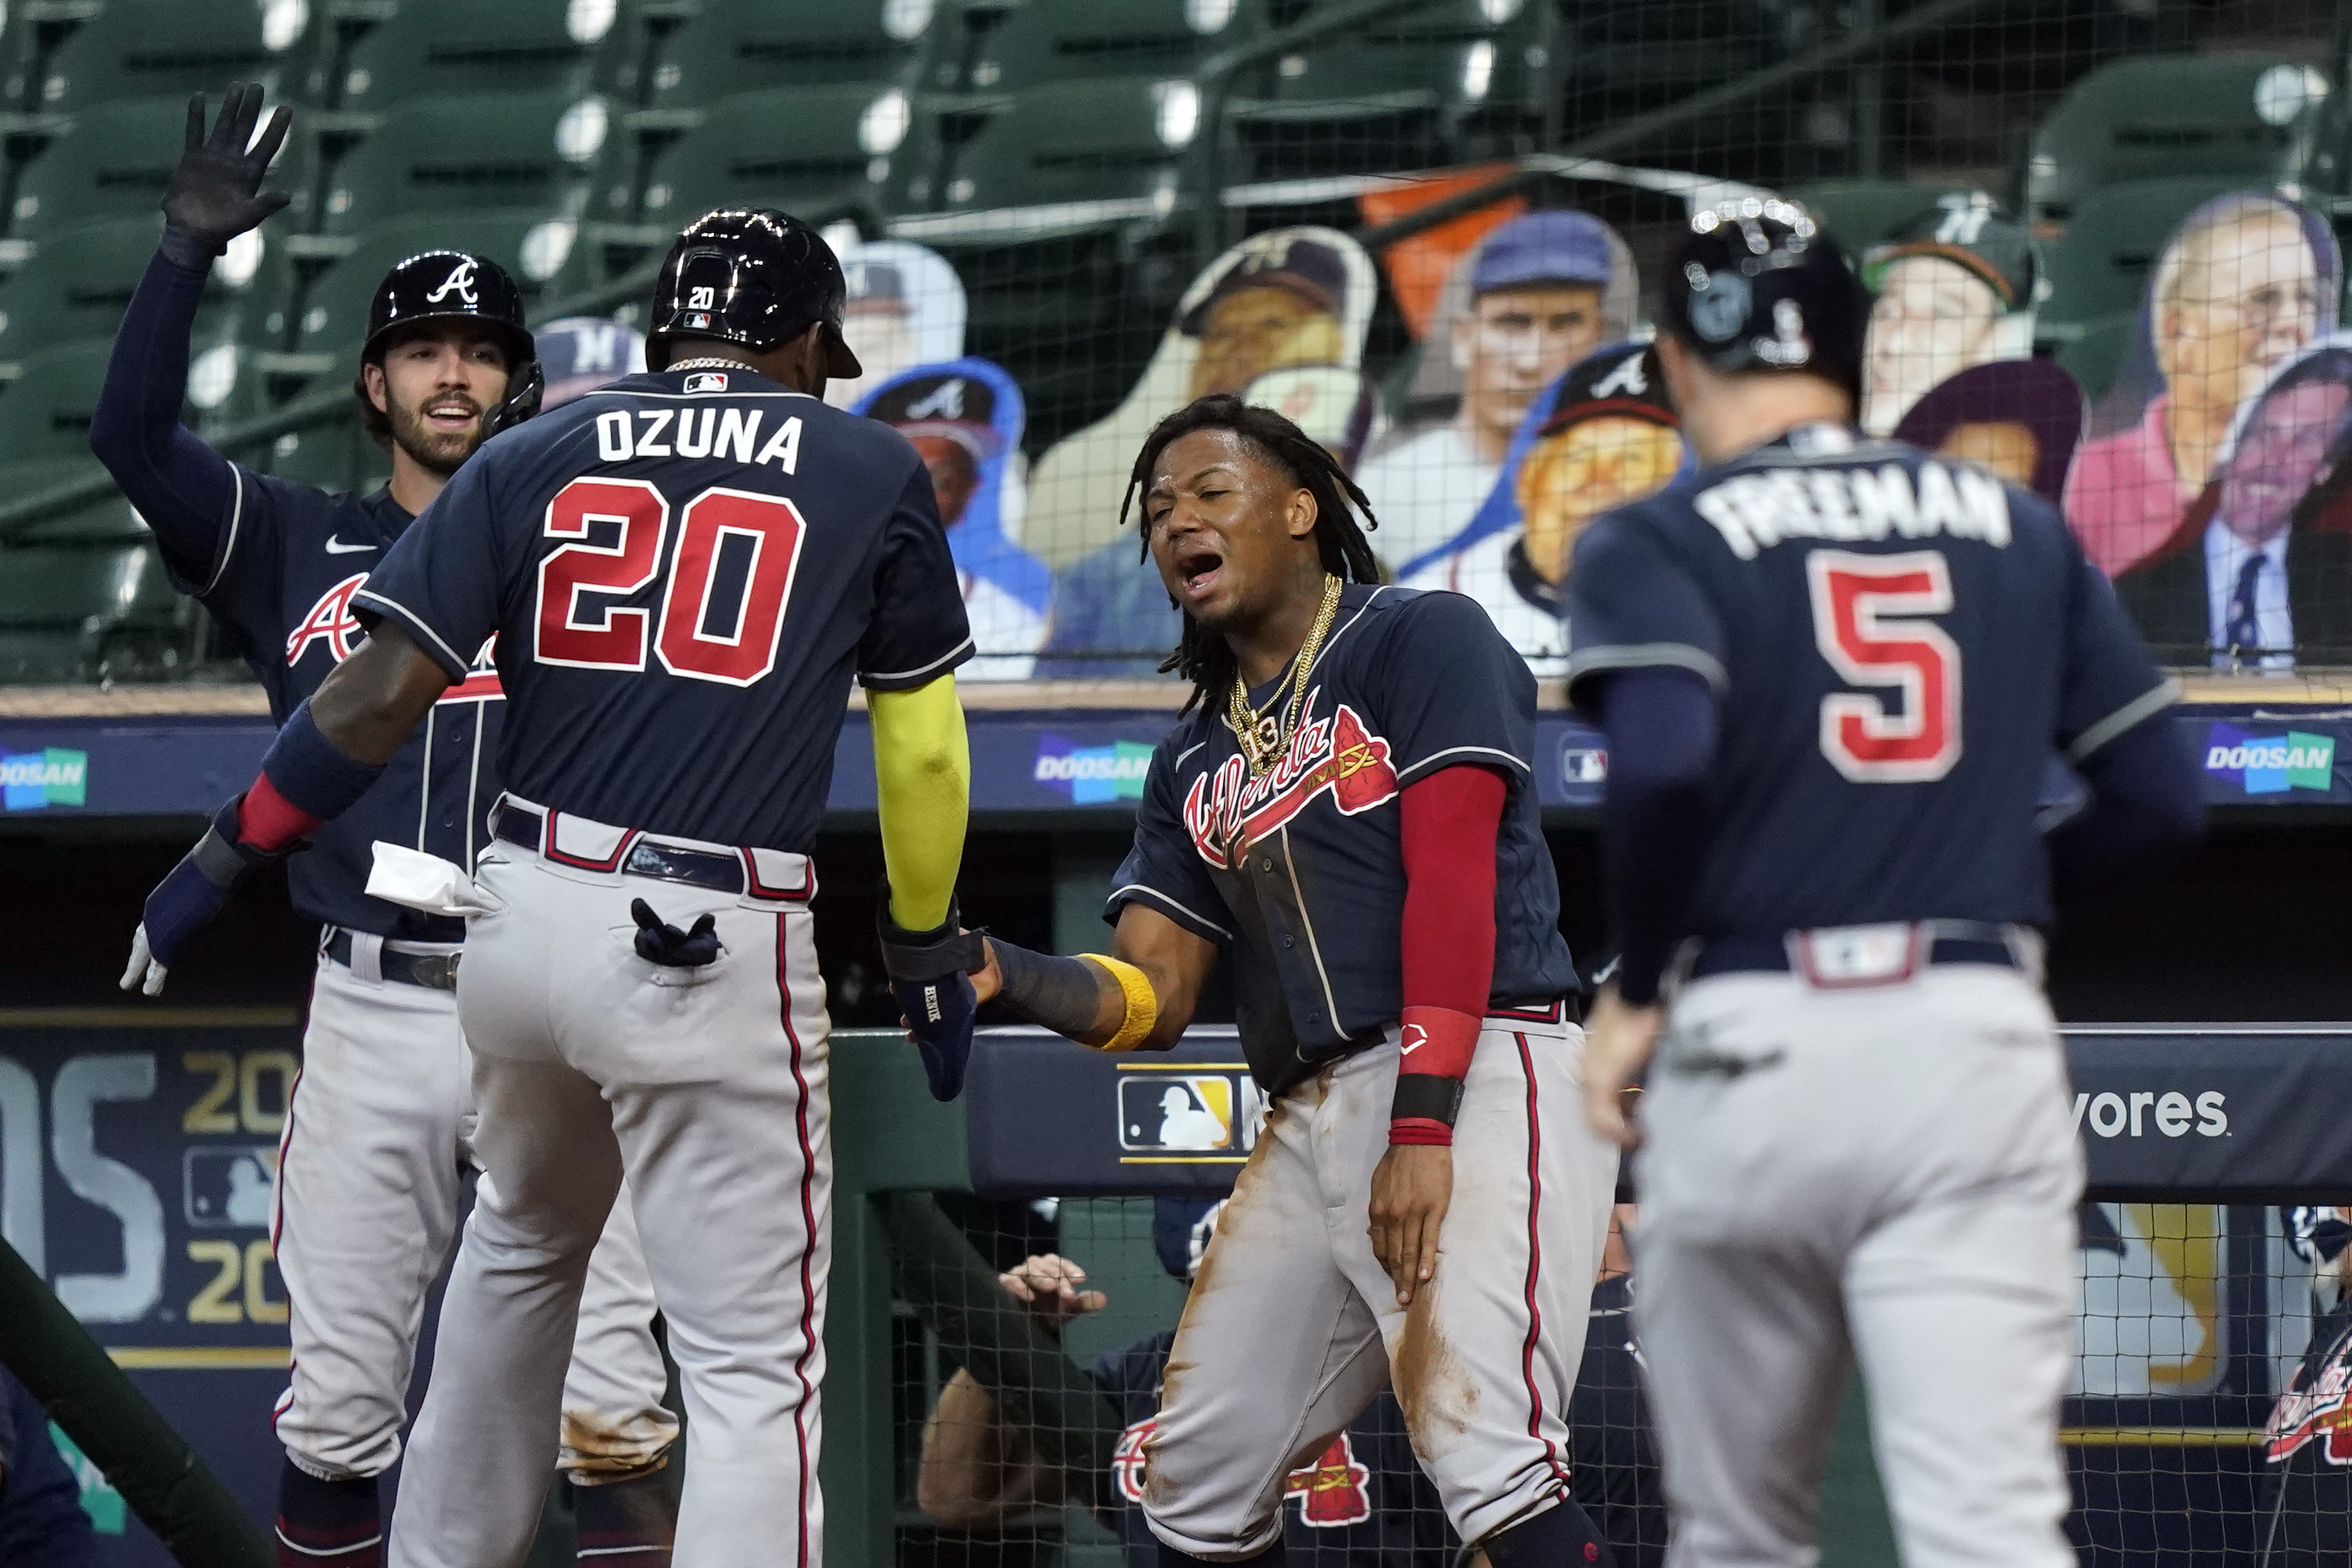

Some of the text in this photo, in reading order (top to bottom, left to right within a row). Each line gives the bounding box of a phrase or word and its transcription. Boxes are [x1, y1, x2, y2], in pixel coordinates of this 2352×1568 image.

[426, 261, 479, 304] A
[688, 286, 715, 310] 20
[596, 408, 803, 475] OZUNA
[1692, 461, 2013, 560] FREEMAN
[534, 476, 807, 688] 20
[1805, 549, 1963, 783] 5
[1183, 684, 1332, 870] Atlanta
[2206, 745, 2331, 770] DOOSAN
